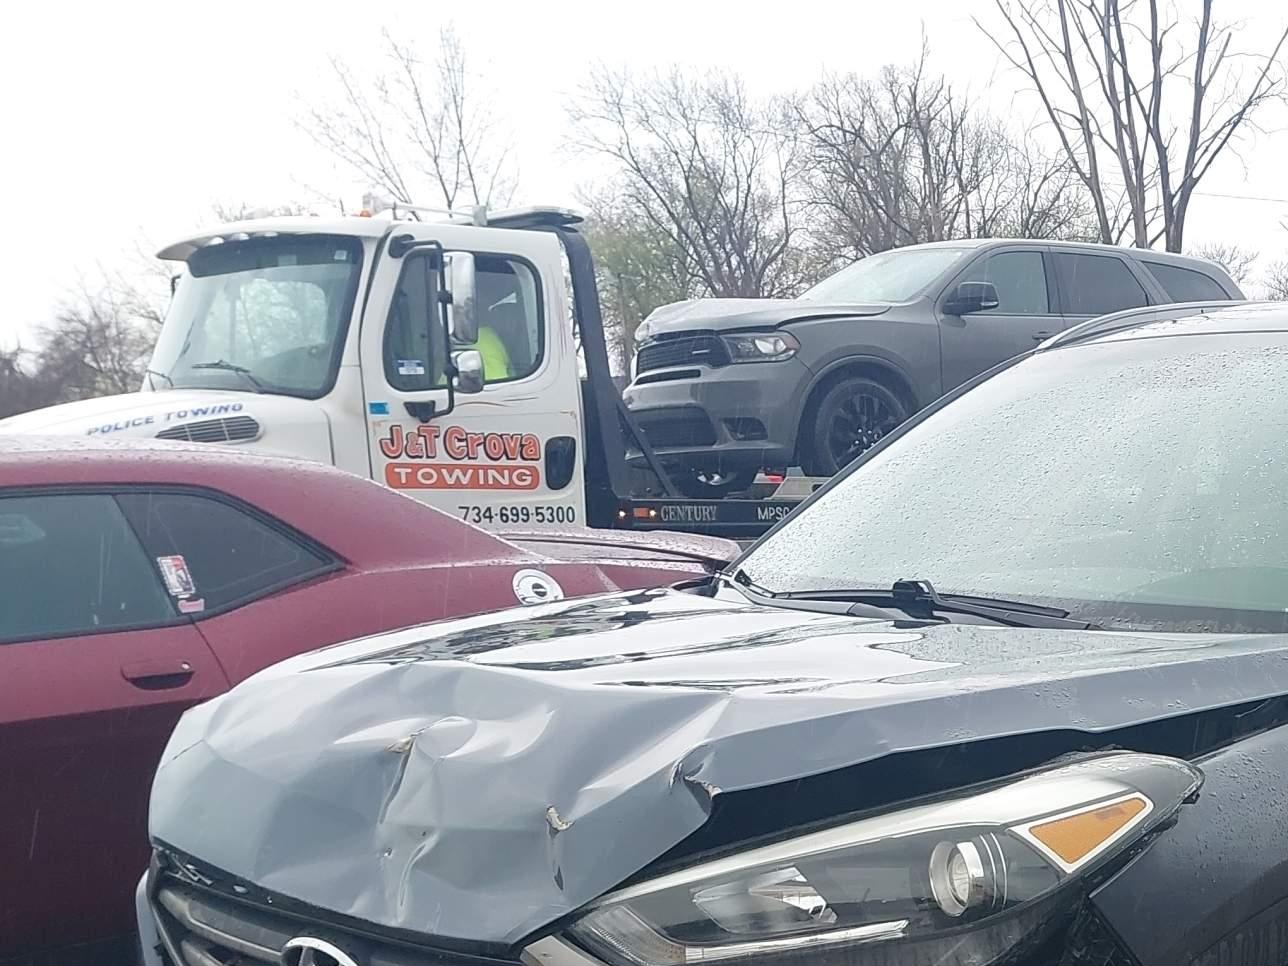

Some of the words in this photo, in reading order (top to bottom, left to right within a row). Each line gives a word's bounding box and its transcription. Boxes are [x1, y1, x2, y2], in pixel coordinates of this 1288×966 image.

[87, 415, 155, 435] POLICE
[166, 403, 244, 421] TOWING
[380, 425, 440, 459] J&T
[443, 426, 541, 460] Crova
[394, 468, 533, 486] TOWING
[660, 505, 718, 521] CENTURY
